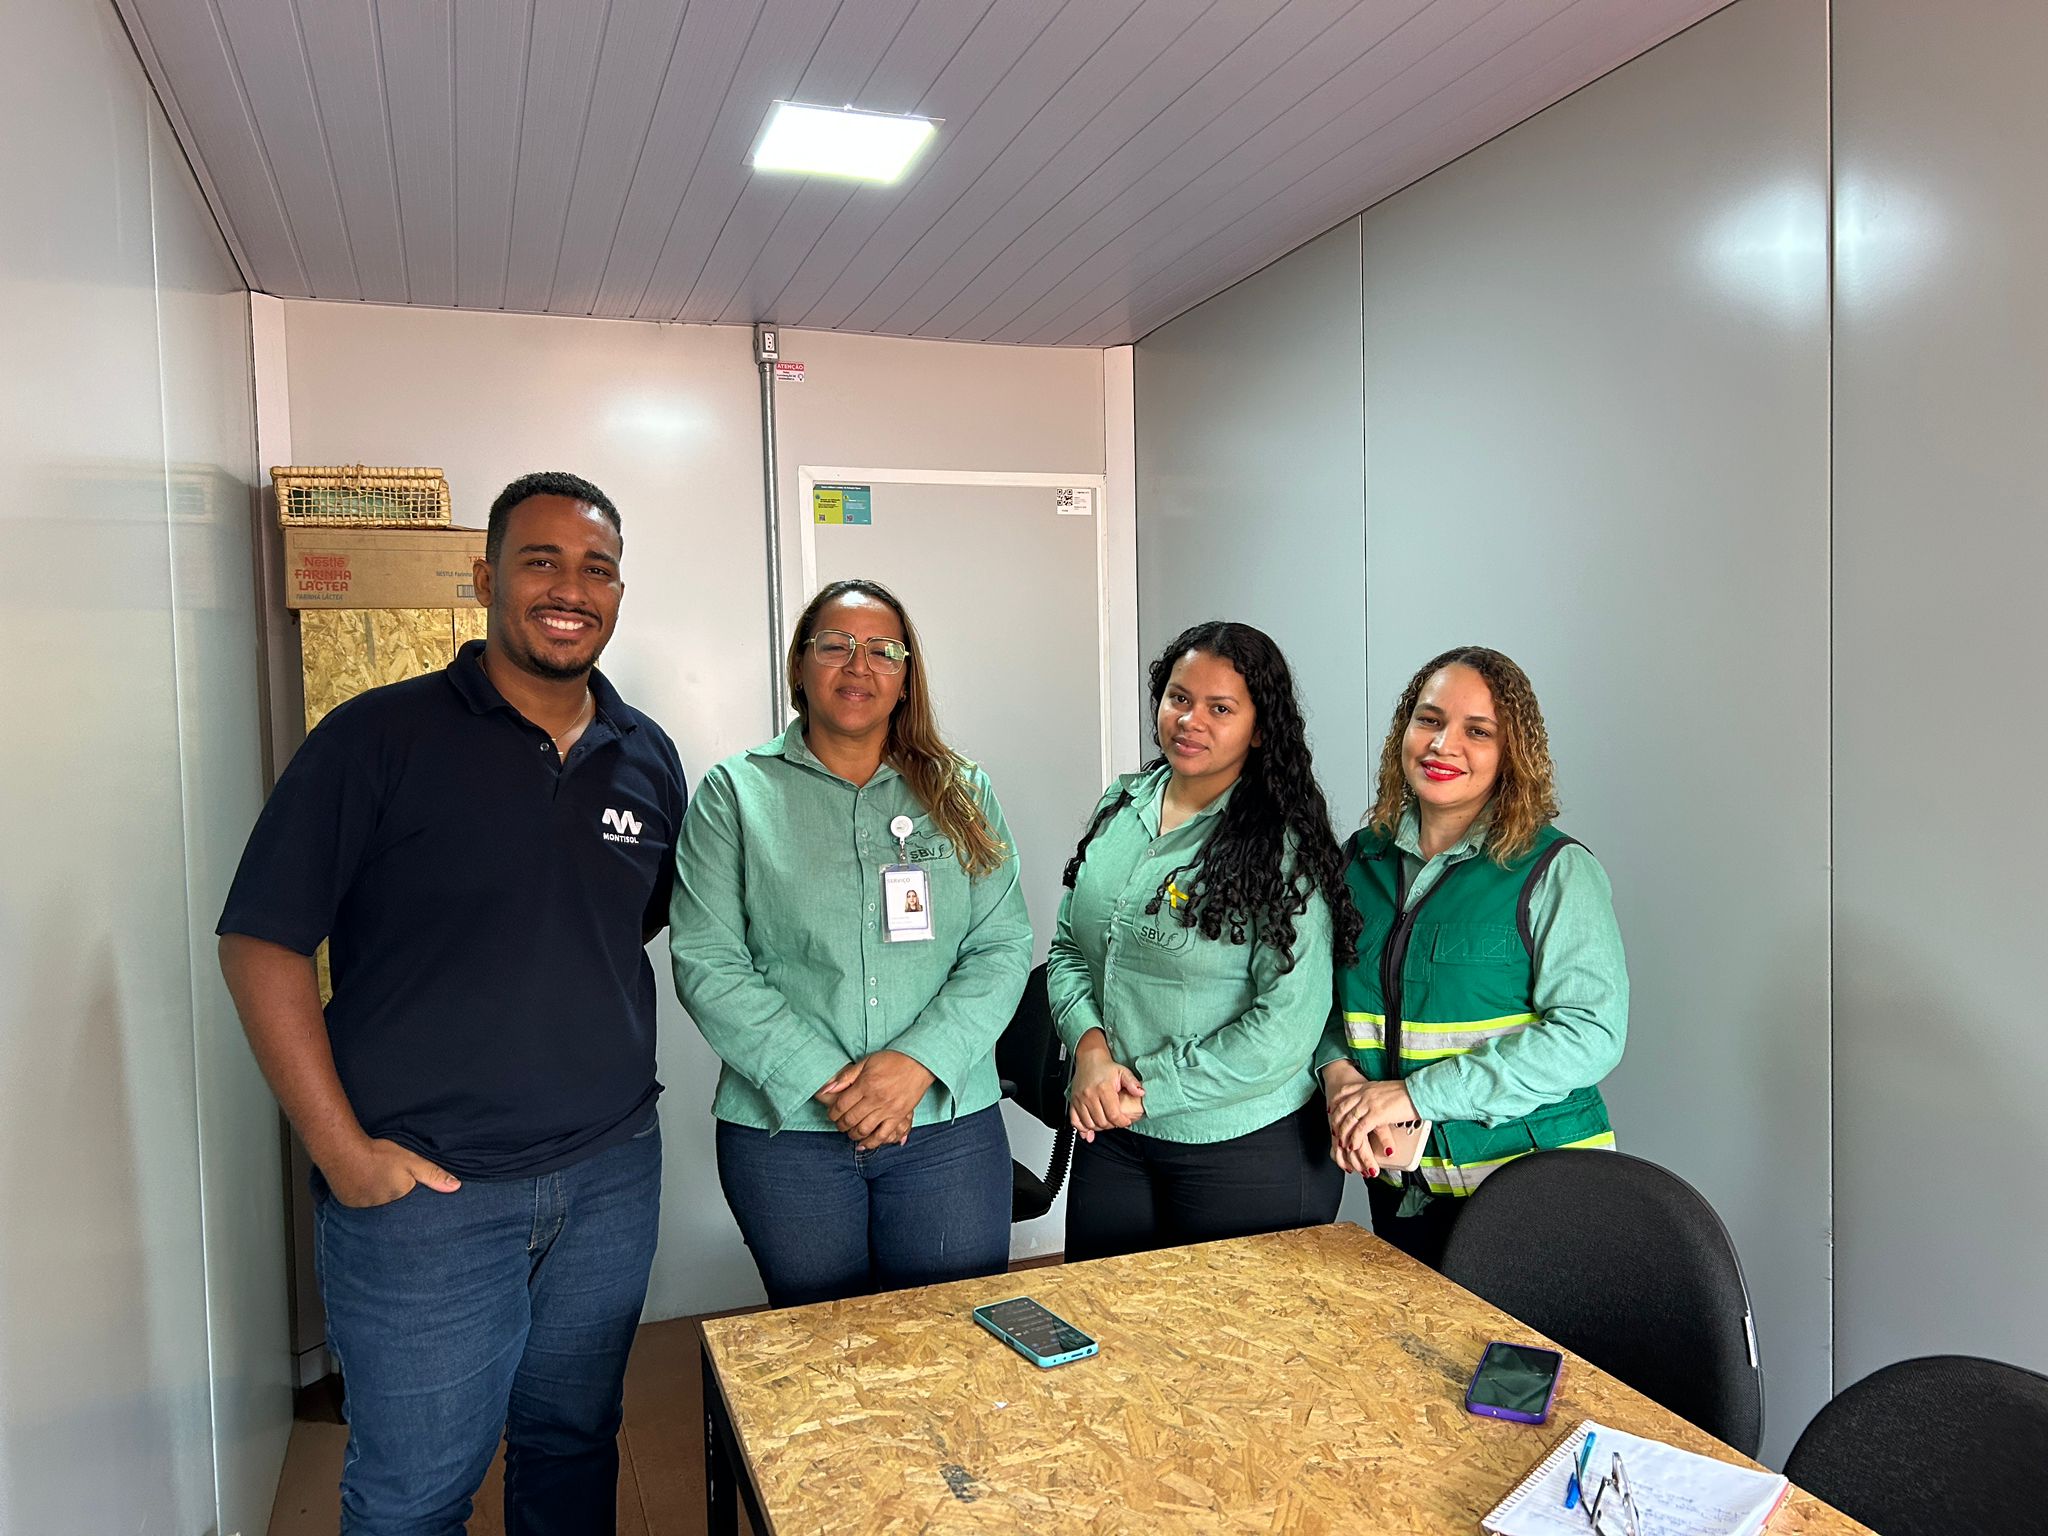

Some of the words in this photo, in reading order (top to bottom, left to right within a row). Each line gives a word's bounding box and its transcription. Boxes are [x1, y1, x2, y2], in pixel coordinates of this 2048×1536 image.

[294, 569, 352, 580] FARINHA
[299, 580, 349, 592] LÁCTEA
[602, 832, 640, 844] MONTISOL
[910, 847, 935, 859] SBV
[1140, 925, 1166, 942] SBV
